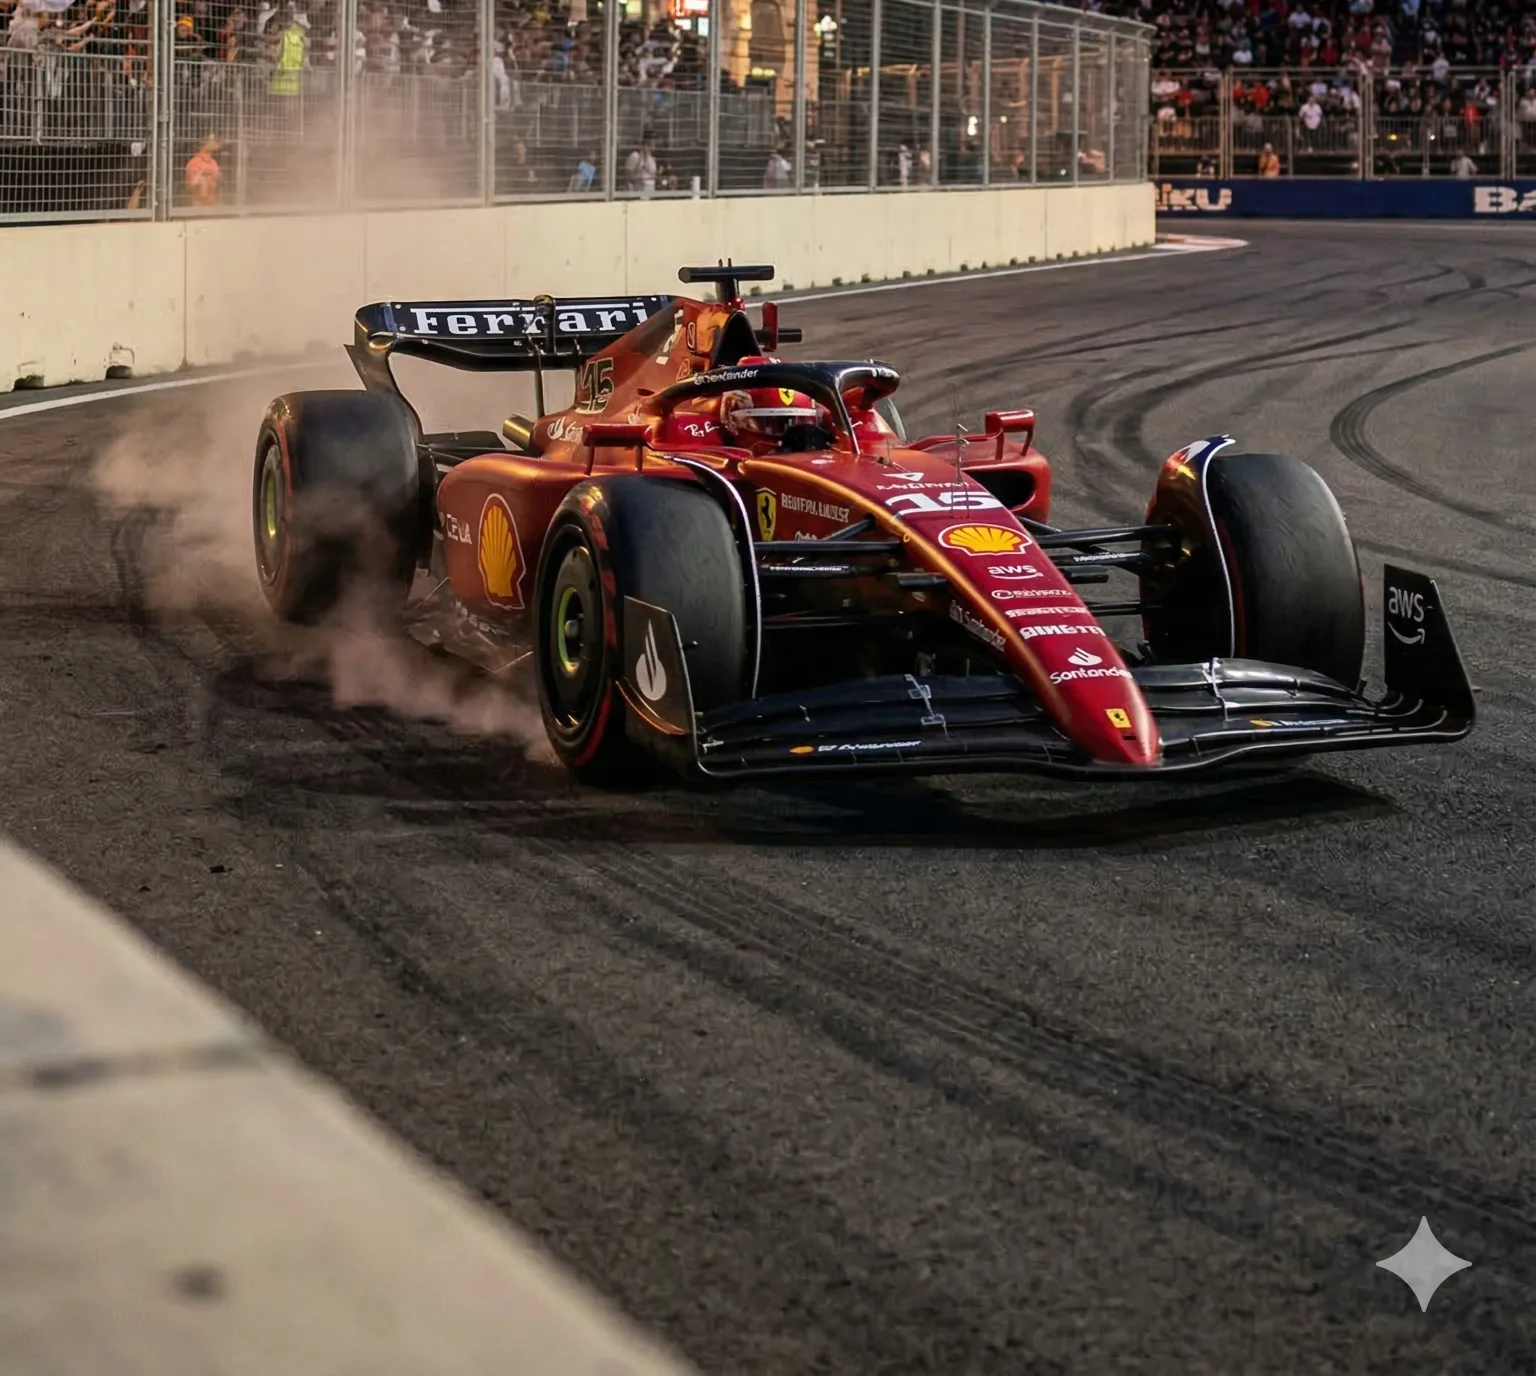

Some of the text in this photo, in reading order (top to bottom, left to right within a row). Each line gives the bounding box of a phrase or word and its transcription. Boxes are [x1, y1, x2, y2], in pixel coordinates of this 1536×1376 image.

[410, 302, 649, 334] Ferrari
[987, 565, 1038, 575] aws
[1388, 586, 1424, 623] aws
